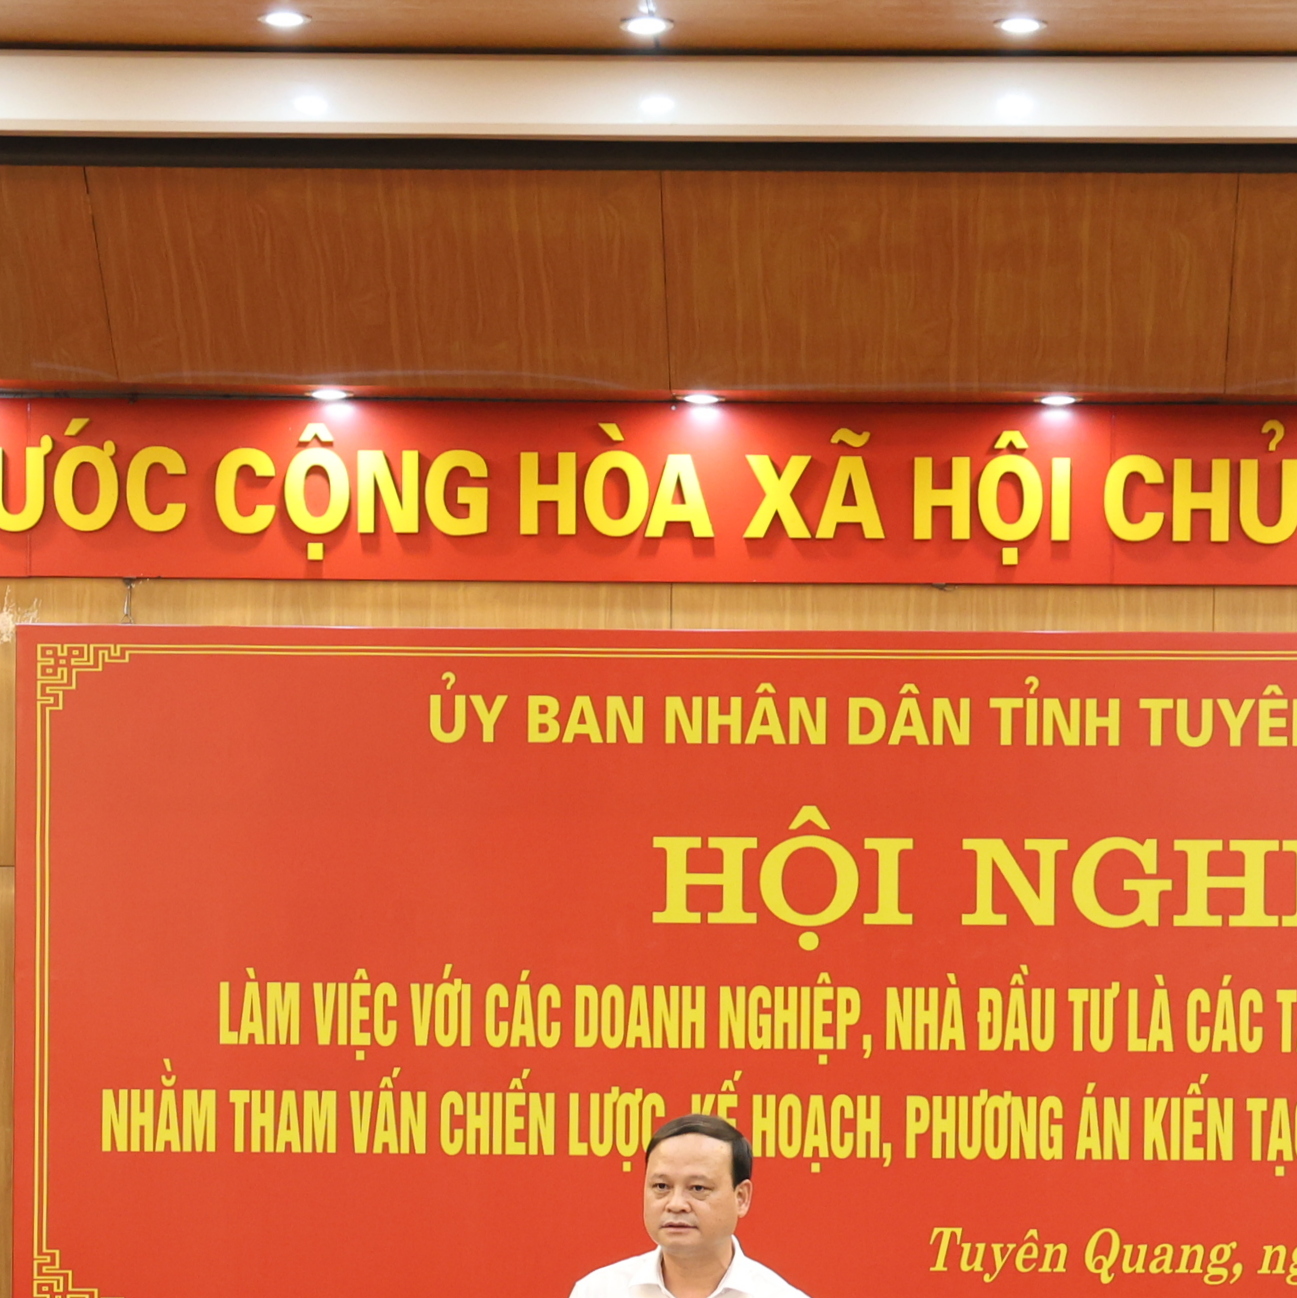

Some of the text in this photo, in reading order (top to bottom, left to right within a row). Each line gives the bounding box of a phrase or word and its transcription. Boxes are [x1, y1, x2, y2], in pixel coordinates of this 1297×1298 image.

[215, 424, 488, 560] CỘNG
[520, 424, 715, 537] HÒA
[743, 429, 885, 538] XÃ
[914, 430, 1073, 564] HỘI
[430, 672, 508, 743] ỦY
[528, 695, 643, 743] BAN
[665, 683, 826, 744] NHÂN
[848, 684, 970, 745] DÂN
[990, 676, 1120, 746] TỈNH
[653, 806, 913, 951] HỘI
[219, 968, 300, 1045] LÀM
[313, 969, 400, 1062] VIỆC
[410, 964, 473, 1047] VỚI
[485, 970, 561, 1049] CÁC
[575, 984, 705, 1049] DOANH
[719, 972, 871, 1064] NGHIỆP,
[886, 973, 965, 1050] NHÀ
[977, 965, 1055, 1052] ĐẦU
[1068, 982, 1120, 1052] TƯ
[1128, 974, 1173, 1052] LÀ
[1187, 975, 1263, 1053] CÁC
[102, 1059, 216, 1152] NHẰM
[229, 1090, 336, 1153] THAM
[350, 1068, 426, 1154] VẤN
[440, 1069, 555, 1155] CHIẾN
[752, 1094, 891, 1173] HOẠCH,
[906, 1089, 1063, 1160] PHƯƠNG
[1076, 1082, 1130, 1160] ÁN
[1144, 1073, 1233, 1161] KIẾN
[930, 1228, 1067, 1283] Tuyên
[1085, 1228, 1242, 1286] Quang,
